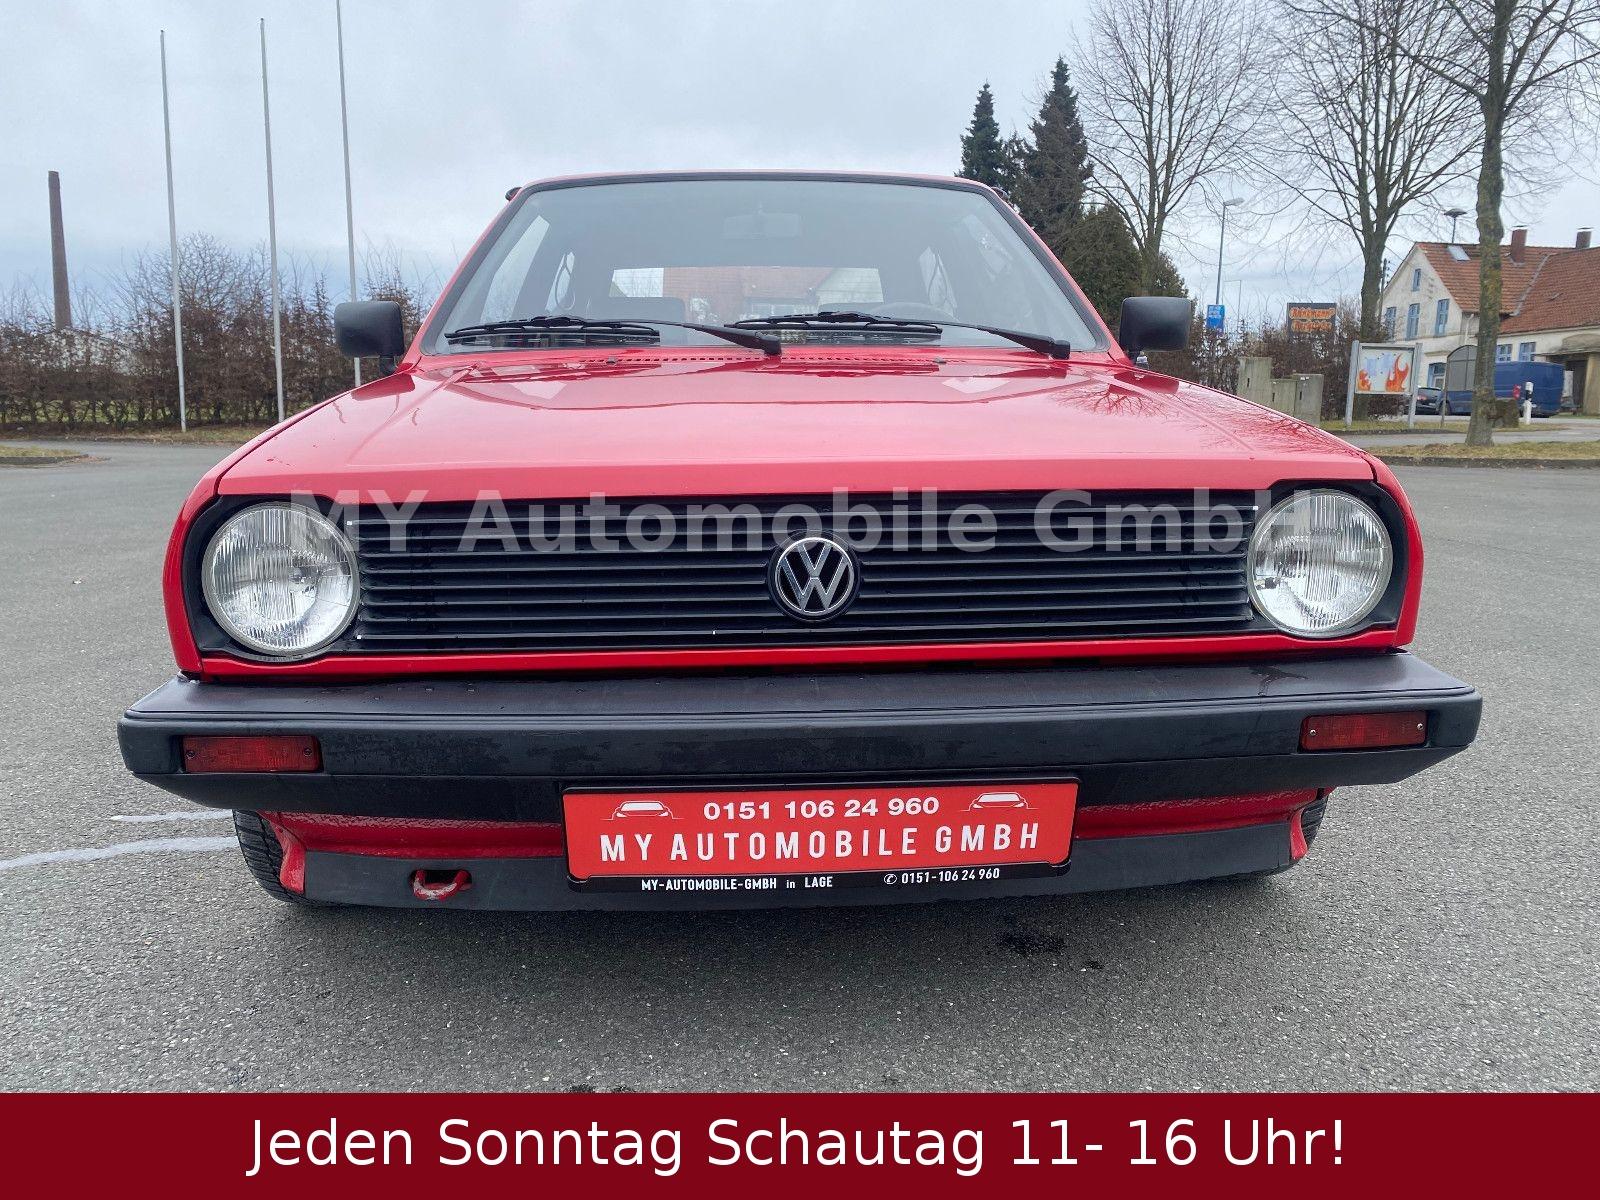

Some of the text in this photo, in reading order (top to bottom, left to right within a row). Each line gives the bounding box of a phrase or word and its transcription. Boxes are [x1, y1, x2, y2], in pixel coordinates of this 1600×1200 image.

[775, 536, 854, 616] VW
[703, 796, 940, 820] 0151 106 24 960
[600, 822, 1039, 862] MY AUTOMOBILE GMBH
[641, 876, 833, 891] MY-AUTOMOBILE-GMBH in LAGE
[901, 867, 1000, 884] 0151-106 24 960
